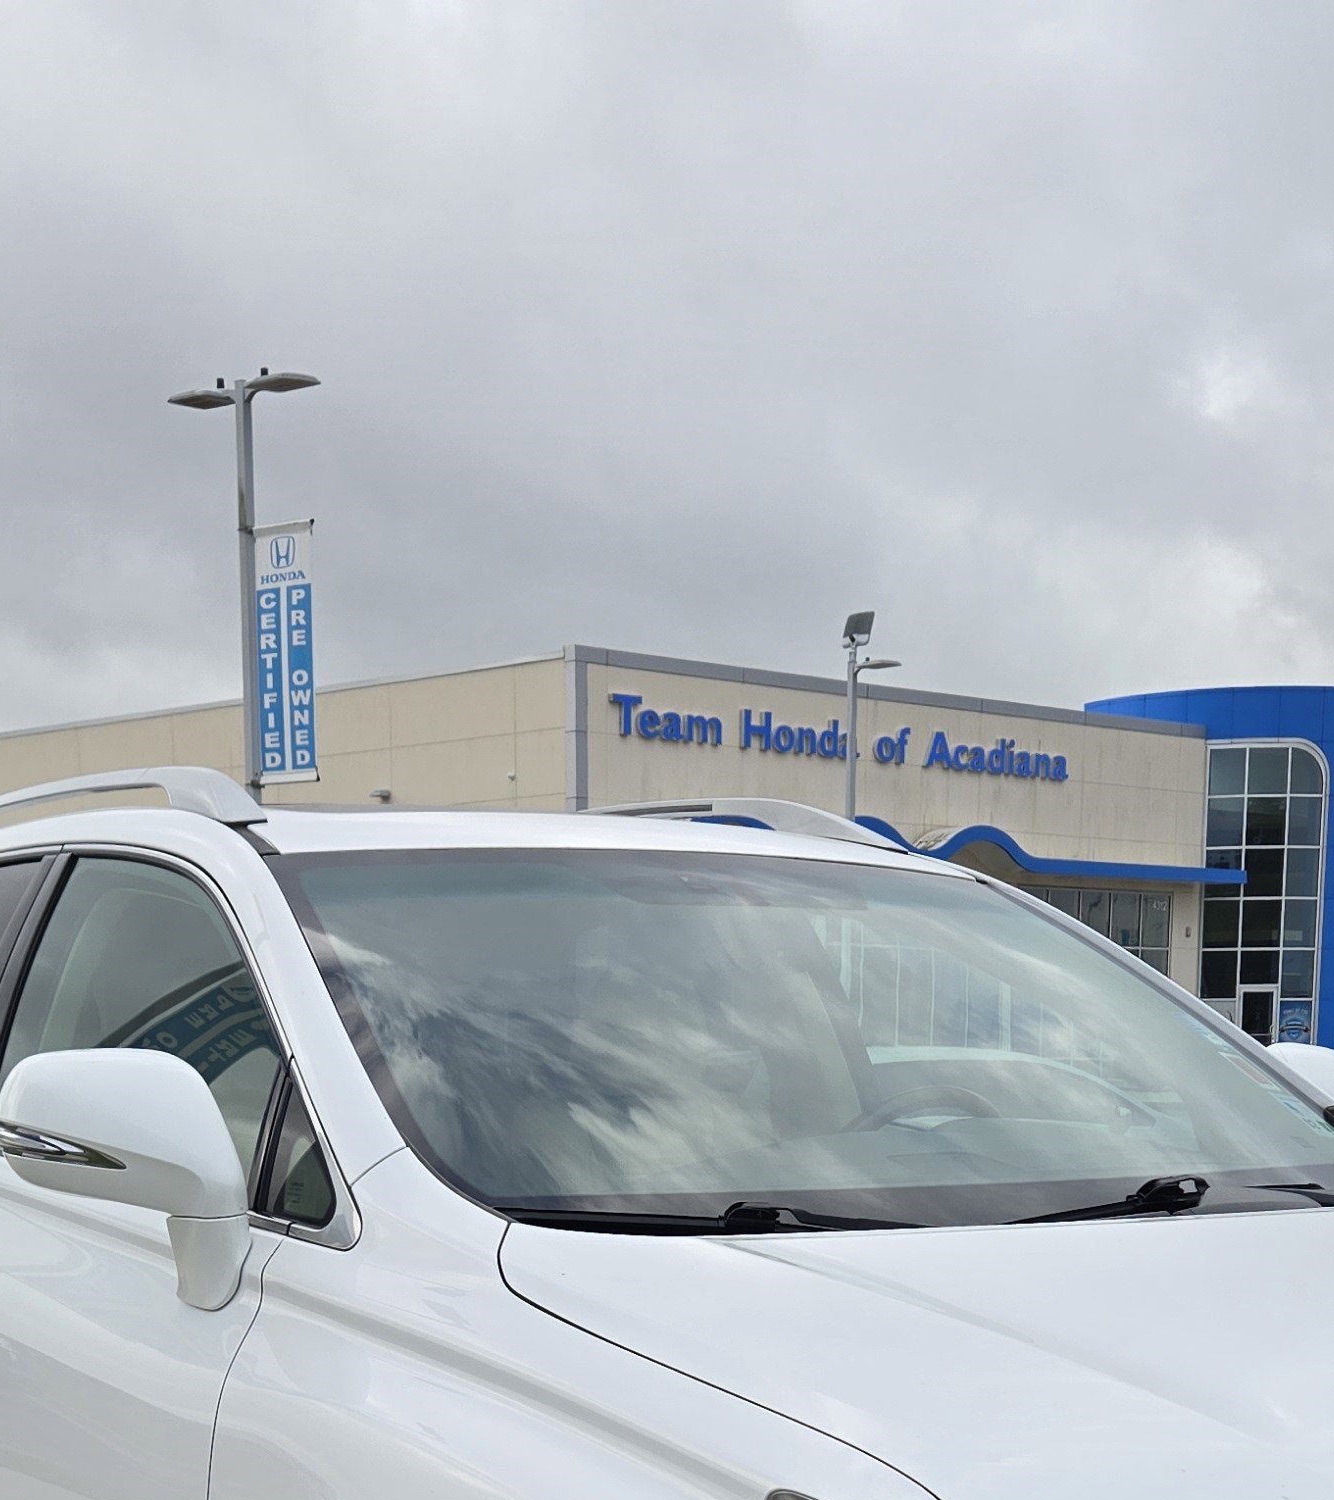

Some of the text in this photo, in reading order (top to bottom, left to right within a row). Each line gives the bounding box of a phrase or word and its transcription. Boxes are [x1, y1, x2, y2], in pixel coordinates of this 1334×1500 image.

[260, 570, 306, 585] HONDA
[259, 592, 282, 768] CERTIFIED
[291, 588, 311, 766] PRE OWNED
[610, 693, 723, 745] Team
[873, 728, 911, 765] of
[923, 731, 1069, 782] Acadiana
